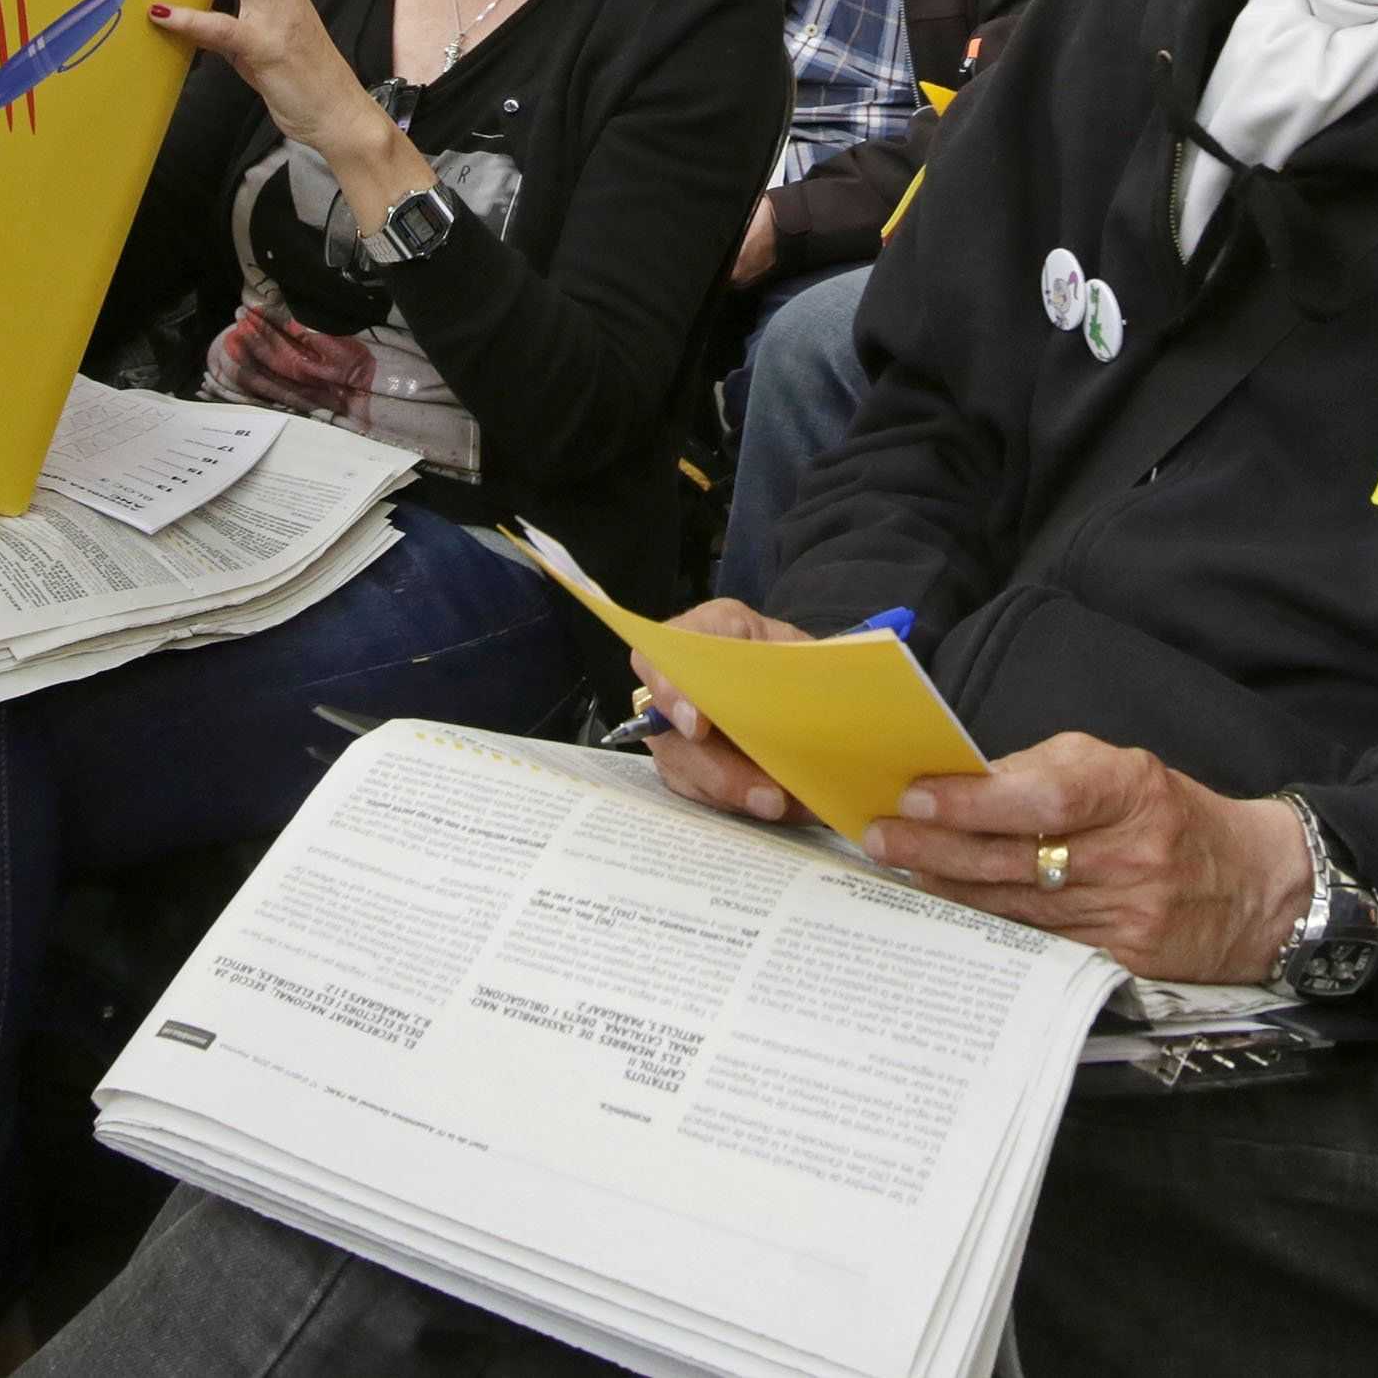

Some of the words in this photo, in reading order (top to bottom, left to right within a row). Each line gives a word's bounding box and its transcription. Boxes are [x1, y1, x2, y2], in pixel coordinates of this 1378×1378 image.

[212, 953, 256, 976] ARTICLE
[226, 971, 267, 994] SECCIÓ
[312, 991, 336, 1007] ELS
[344, 991, 411, 1025] PARÀGRAFS
[340, 1001, 396, 1029] ELECTORS
[500, 1004, 574, 1036] L'ASSEMBLEA
[559, 1008, 598, 1029] DRETS
[583, 1002, 646, 1033] PARÀGRAF
[327, 1009, 401, 1045] SECRETARIAT
[394, 1021, 425, 1040] DELS
[577, 1028, 594, 1041] DE
[657, 1023, 706, 1045] ARTICLE
[401, 1037, 418, 1050] EL
[596, 1032, 657, 1059] MEMBRES
[665, 1039, 699, 1058] ONAL
[659, 1051, 683, 1067] ELS
[621, 1067, 680, 1094] ESTATUTS
[635, 1058, 687, 1084] CAPÍTOL
